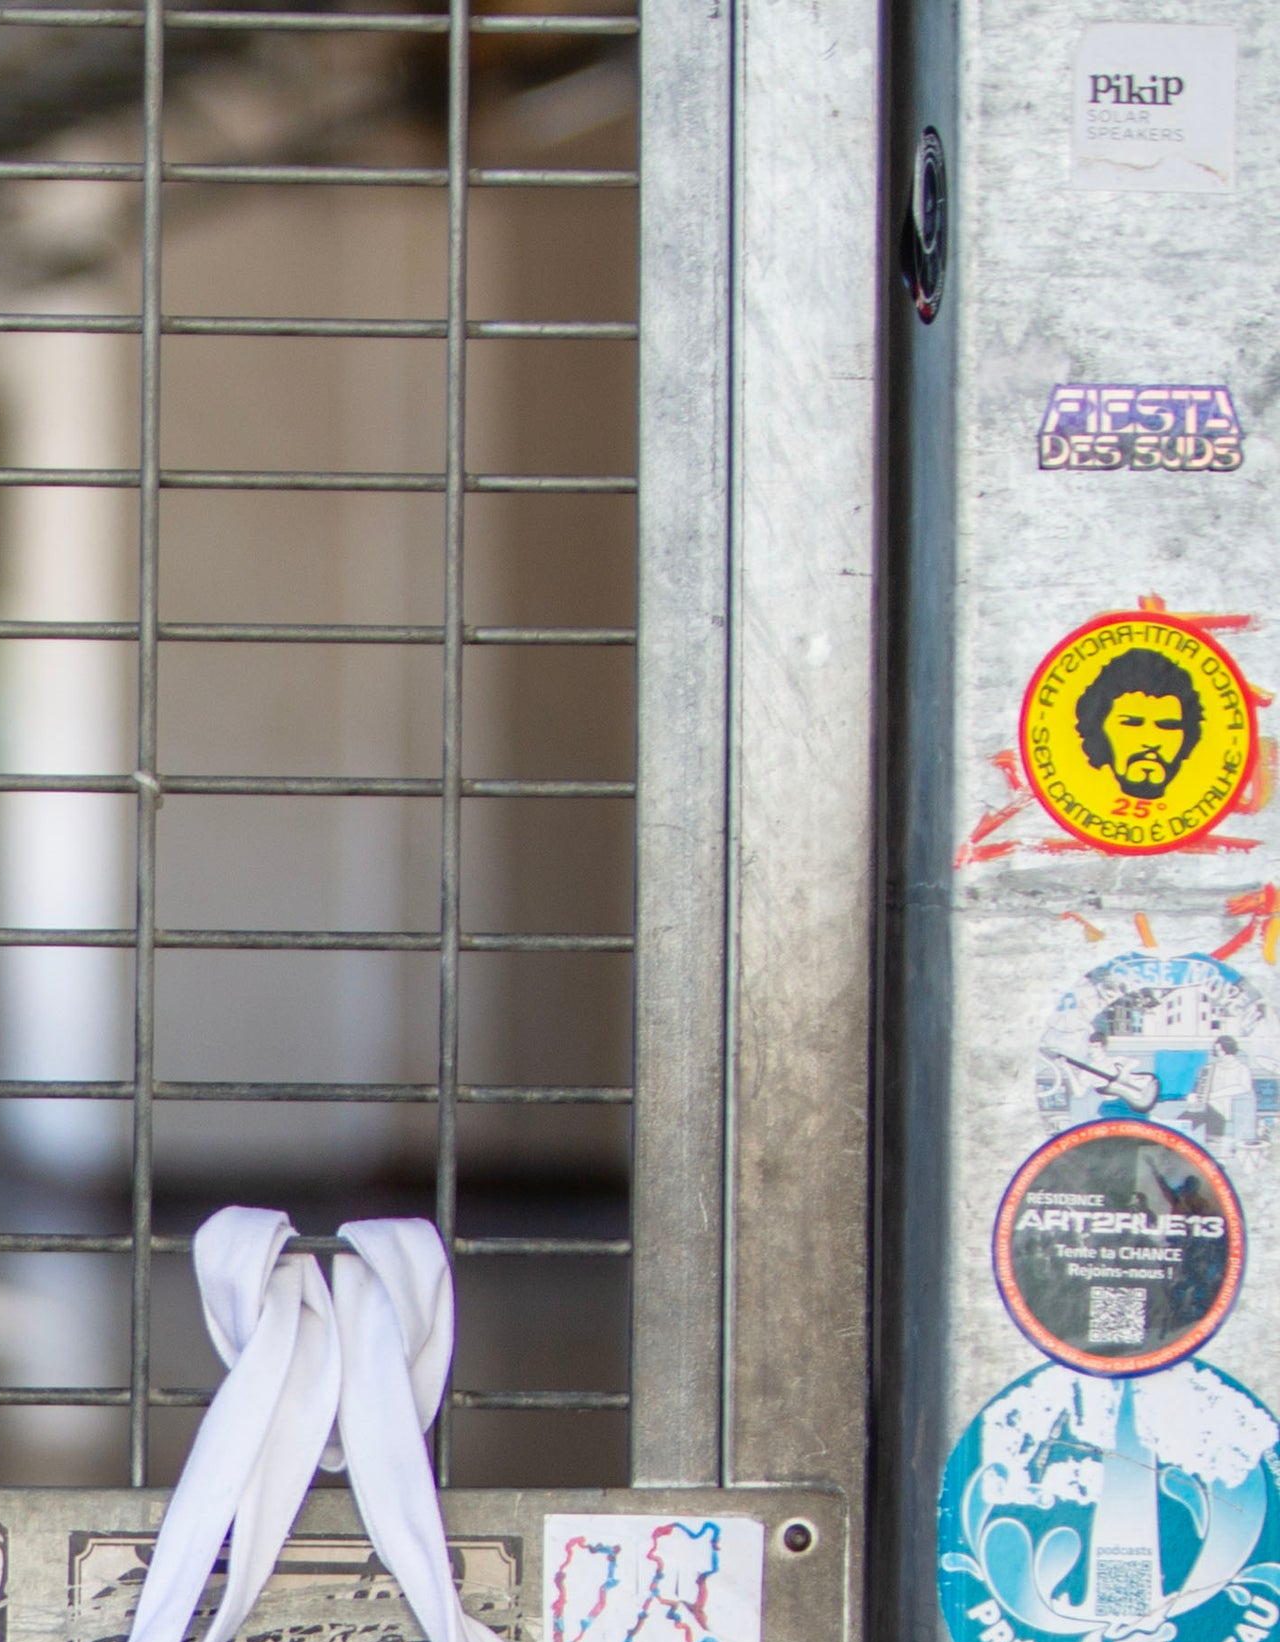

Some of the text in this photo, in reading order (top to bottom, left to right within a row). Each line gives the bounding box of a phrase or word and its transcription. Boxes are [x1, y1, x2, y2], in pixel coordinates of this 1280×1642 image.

[1087, 109, 1150, 123] SOLAR
[1087, 126, 1185, 142] SPEAKERS
[1044, 389, 1239, 434] FIESTA
[1043, 434, 1242, 470] DES SUDS
[1032, 725, 1057, 780] SER
[1055, 1244, 1183, 1262] Tente ta CHANCE
[1096, 1545, 1153, 1557] podcasts
